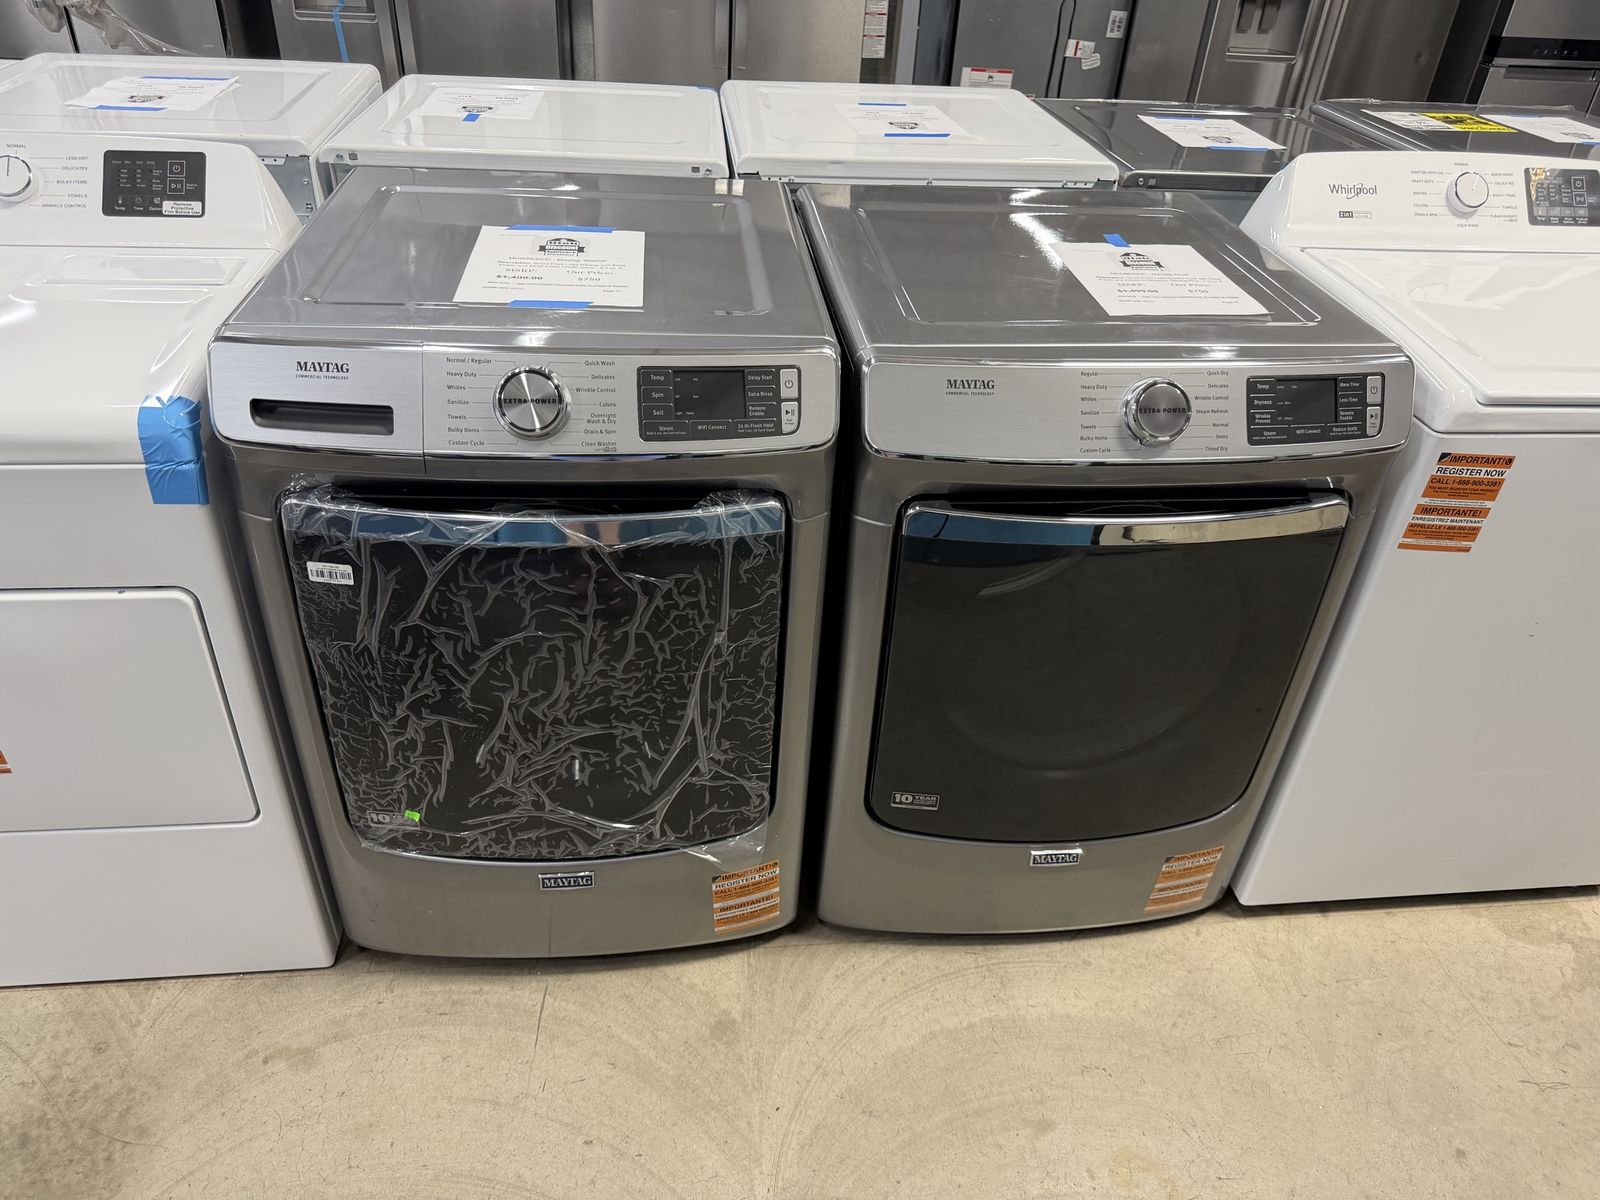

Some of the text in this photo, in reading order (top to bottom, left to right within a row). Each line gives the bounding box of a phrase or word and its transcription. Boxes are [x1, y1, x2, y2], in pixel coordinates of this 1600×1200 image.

[1328, 183, 1377, 199] Whirlpool
[296, 361, 349, 373] MAYTAG
[946, 379, 994, 389] MAYTAG
[1449, 455, 1504, 465] IMPORTANT!
[1436, 467, 1506, 477] REGISTER NOW
[1420, 507, 1482, 517] IMPORTANTE!
[895, 794, 912, 803] 10
[371, 813, 390, 822] 10
[1034, 854, 1078, 863] MAYTAG
[1165, 860, 1201, 869] REGISTER
[722, 863, 772, 880] IMPORTANT!
[543, 877, 592, 888] MAYTAG
[715, 876, 756, 889] REGISTER
[758, 869, 777, 880] NOW
[720, 895, 774, 912] IMPORTANTE!
